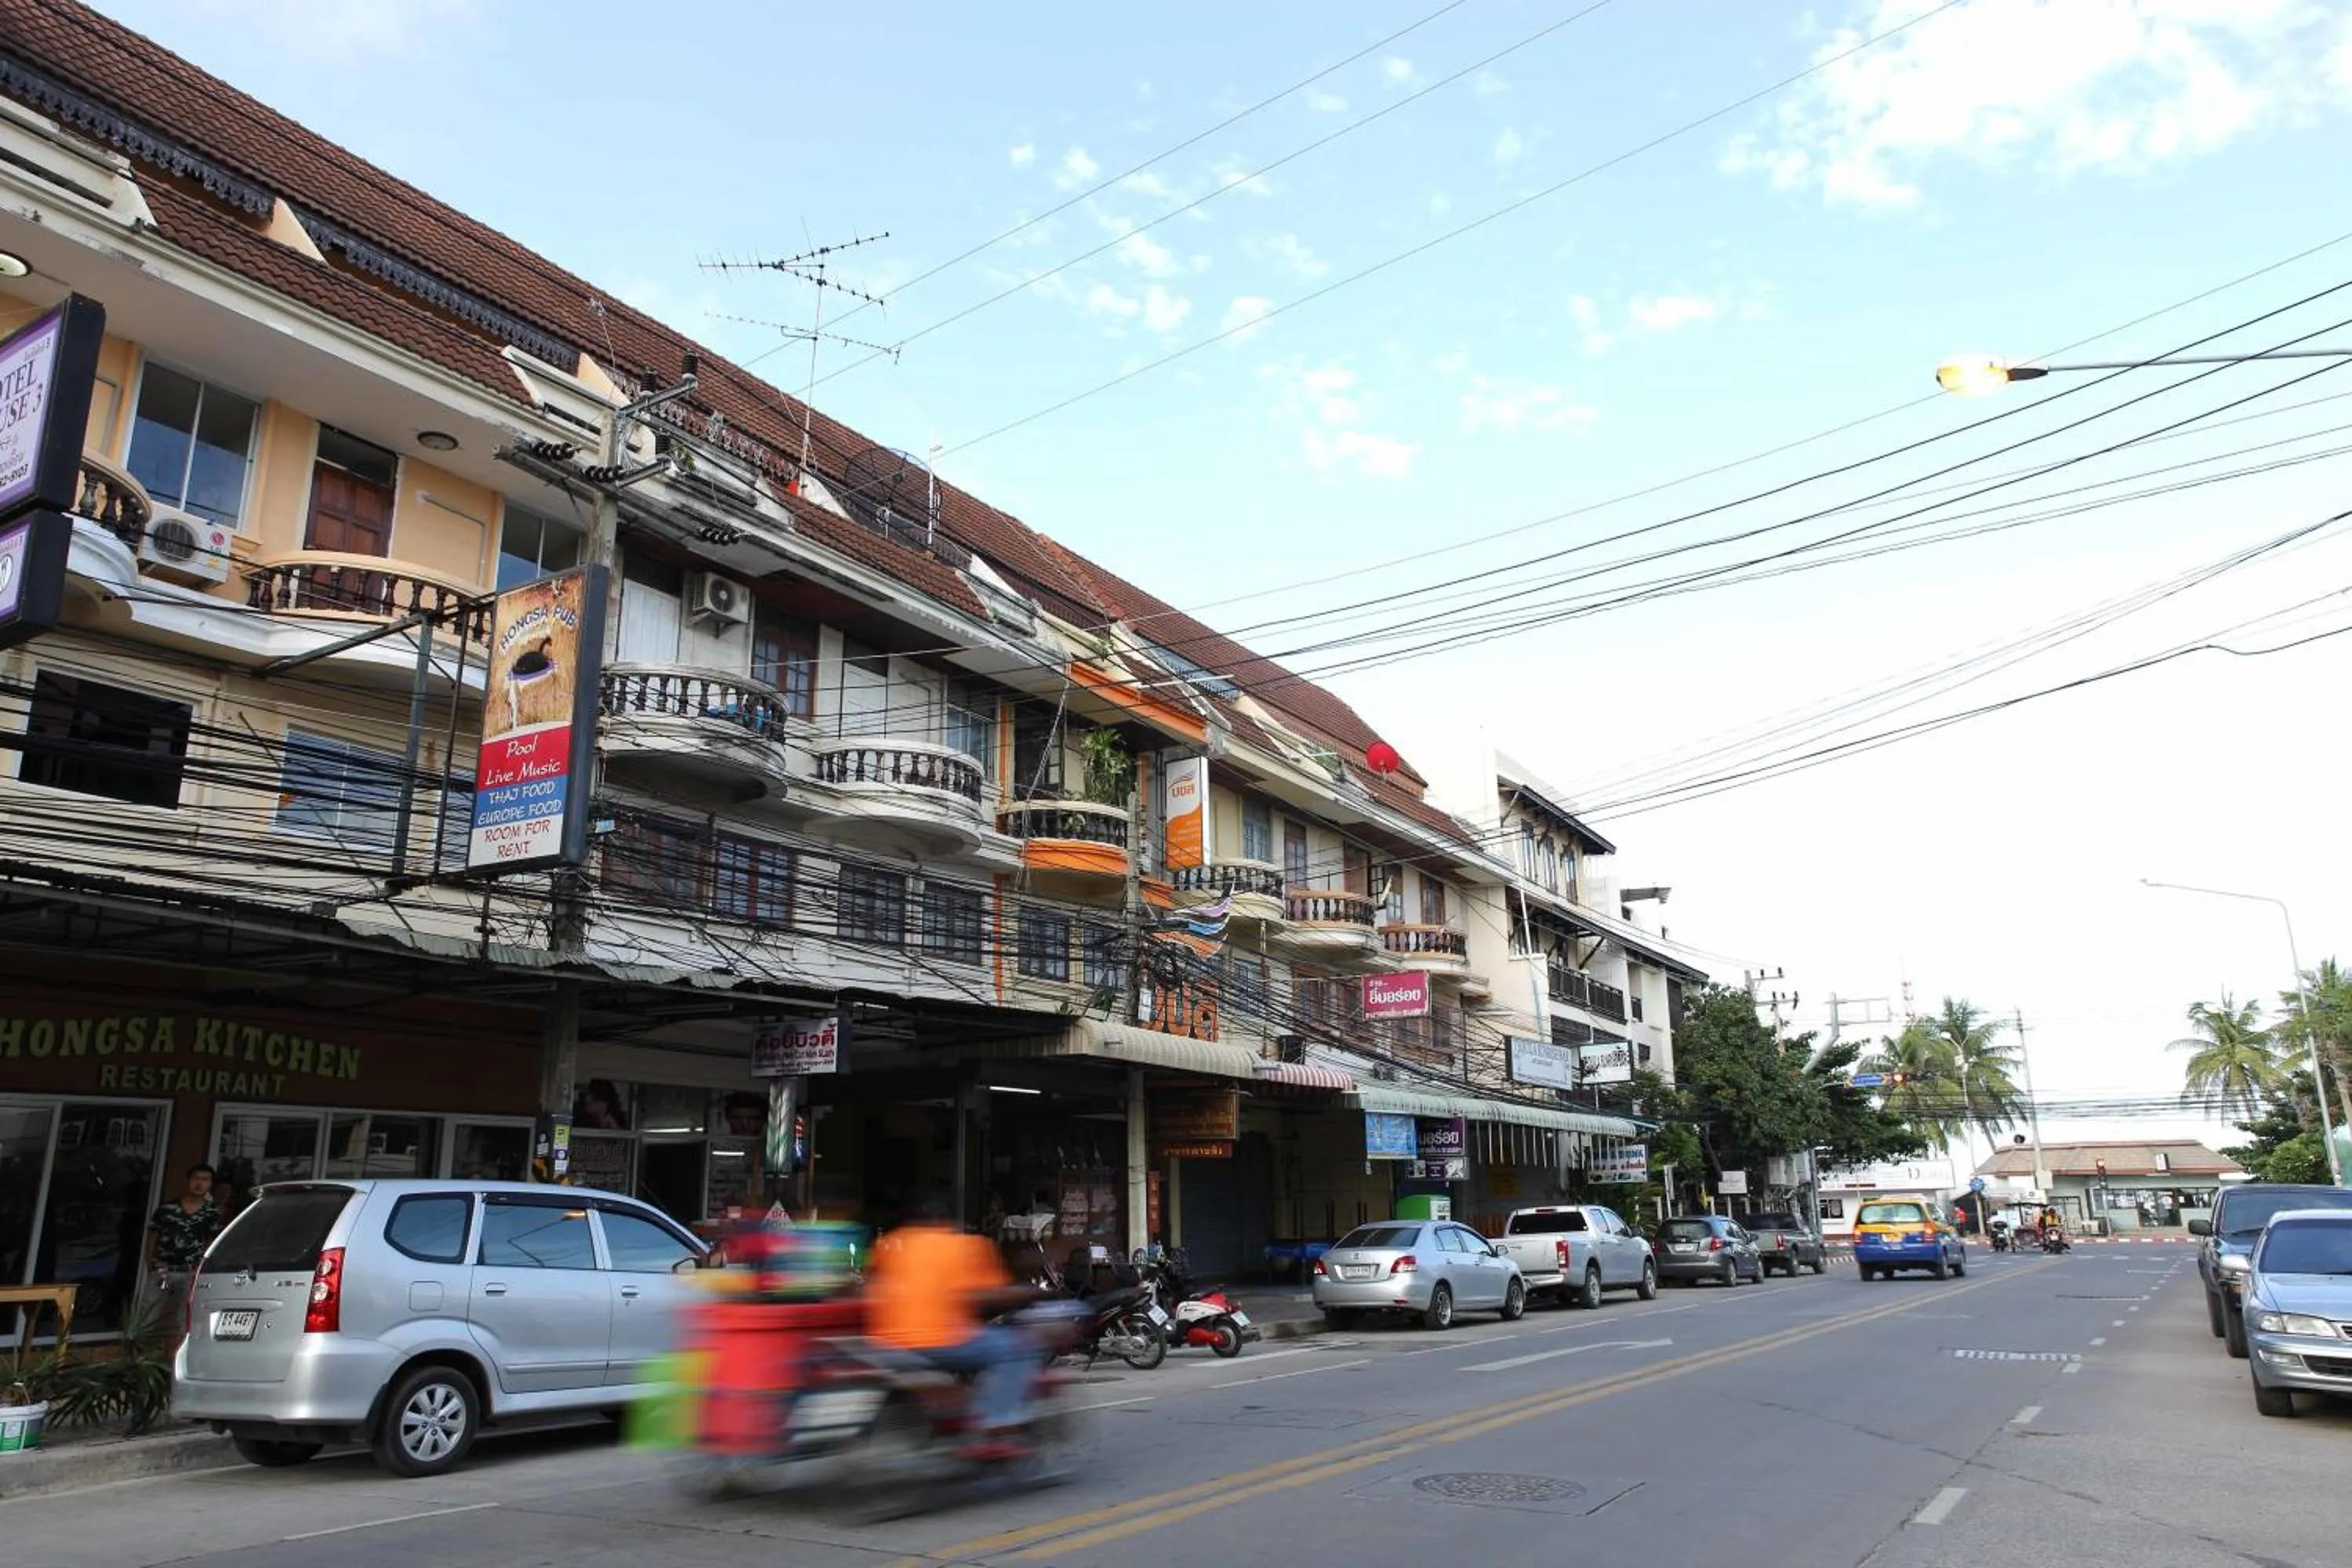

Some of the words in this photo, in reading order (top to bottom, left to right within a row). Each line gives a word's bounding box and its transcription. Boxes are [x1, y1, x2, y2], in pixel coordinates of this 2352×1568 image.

[32, 383, 43, 413] 3
[499, 605, 549, 652] HONGSA
[553, 604, 578, 626] PUB
[506, 734, 539, 759] Pool
[485, 770, 514, 785] Live
[517, 758, 561, 782] Music
[522, 781, 556, 799] FOOD
[477, 806, 525, 826] EUROPE
[528, 799, 563, 816] FOOD
[484, 826, 521, 843] ROOM
[524, 819, 551, 836] FOR
[497, 840, 532, 858] RENT
[0, 1017, 176, 1058] HONGSA
[192, 1017, 362, 1080] KITCHEN
[100, 1064, 287, 1097] RESTAURANT
